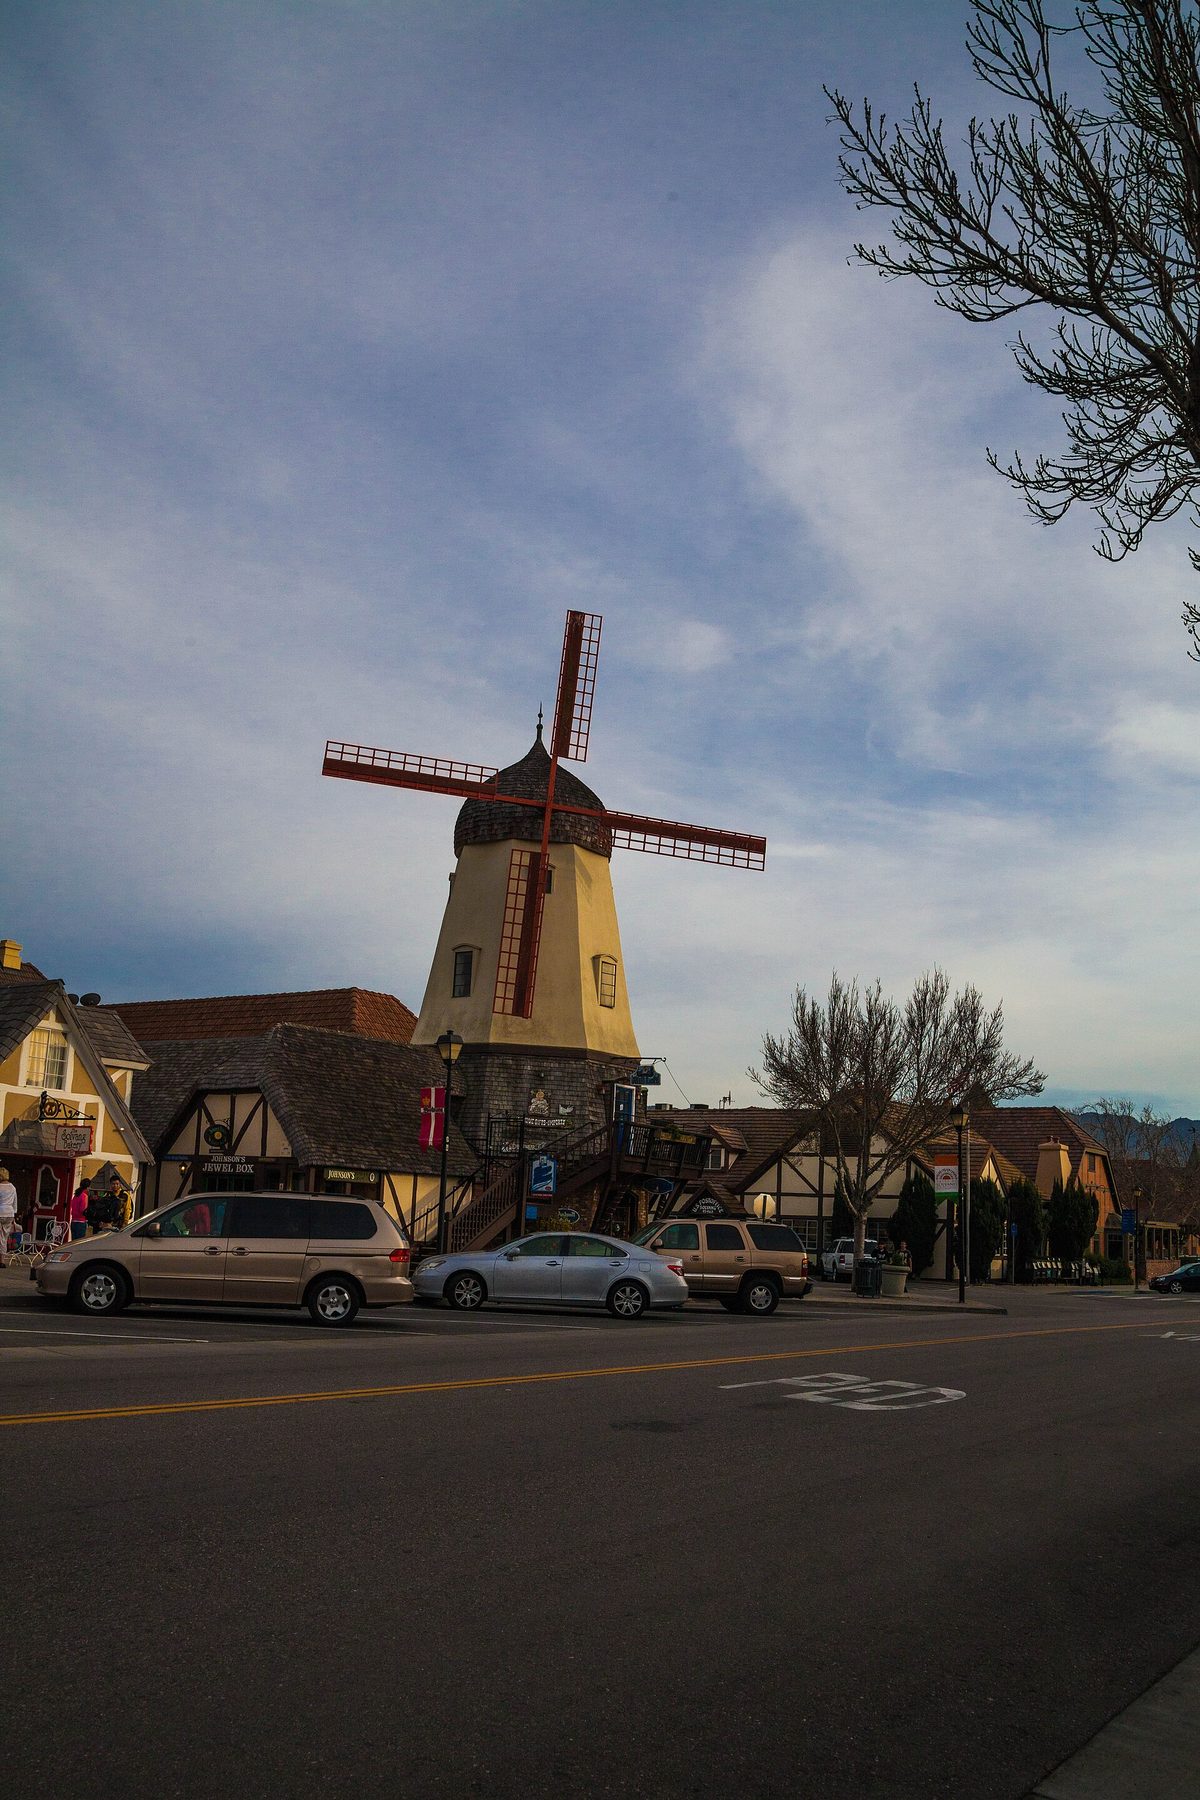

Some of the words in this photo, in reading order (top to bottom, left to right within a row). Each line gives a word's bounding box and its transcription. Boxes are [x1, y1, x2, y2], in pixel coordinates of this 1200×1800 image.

[211, 1155, 246, 1163] JOHNSON'S
[202, 1163, 234, 1173] JEWEL
[236, 1164, 254, 1173] BOX
[327, 1169, 356, 1180] JOHNSON'S
[717, 1372, 967, 1411] PED
